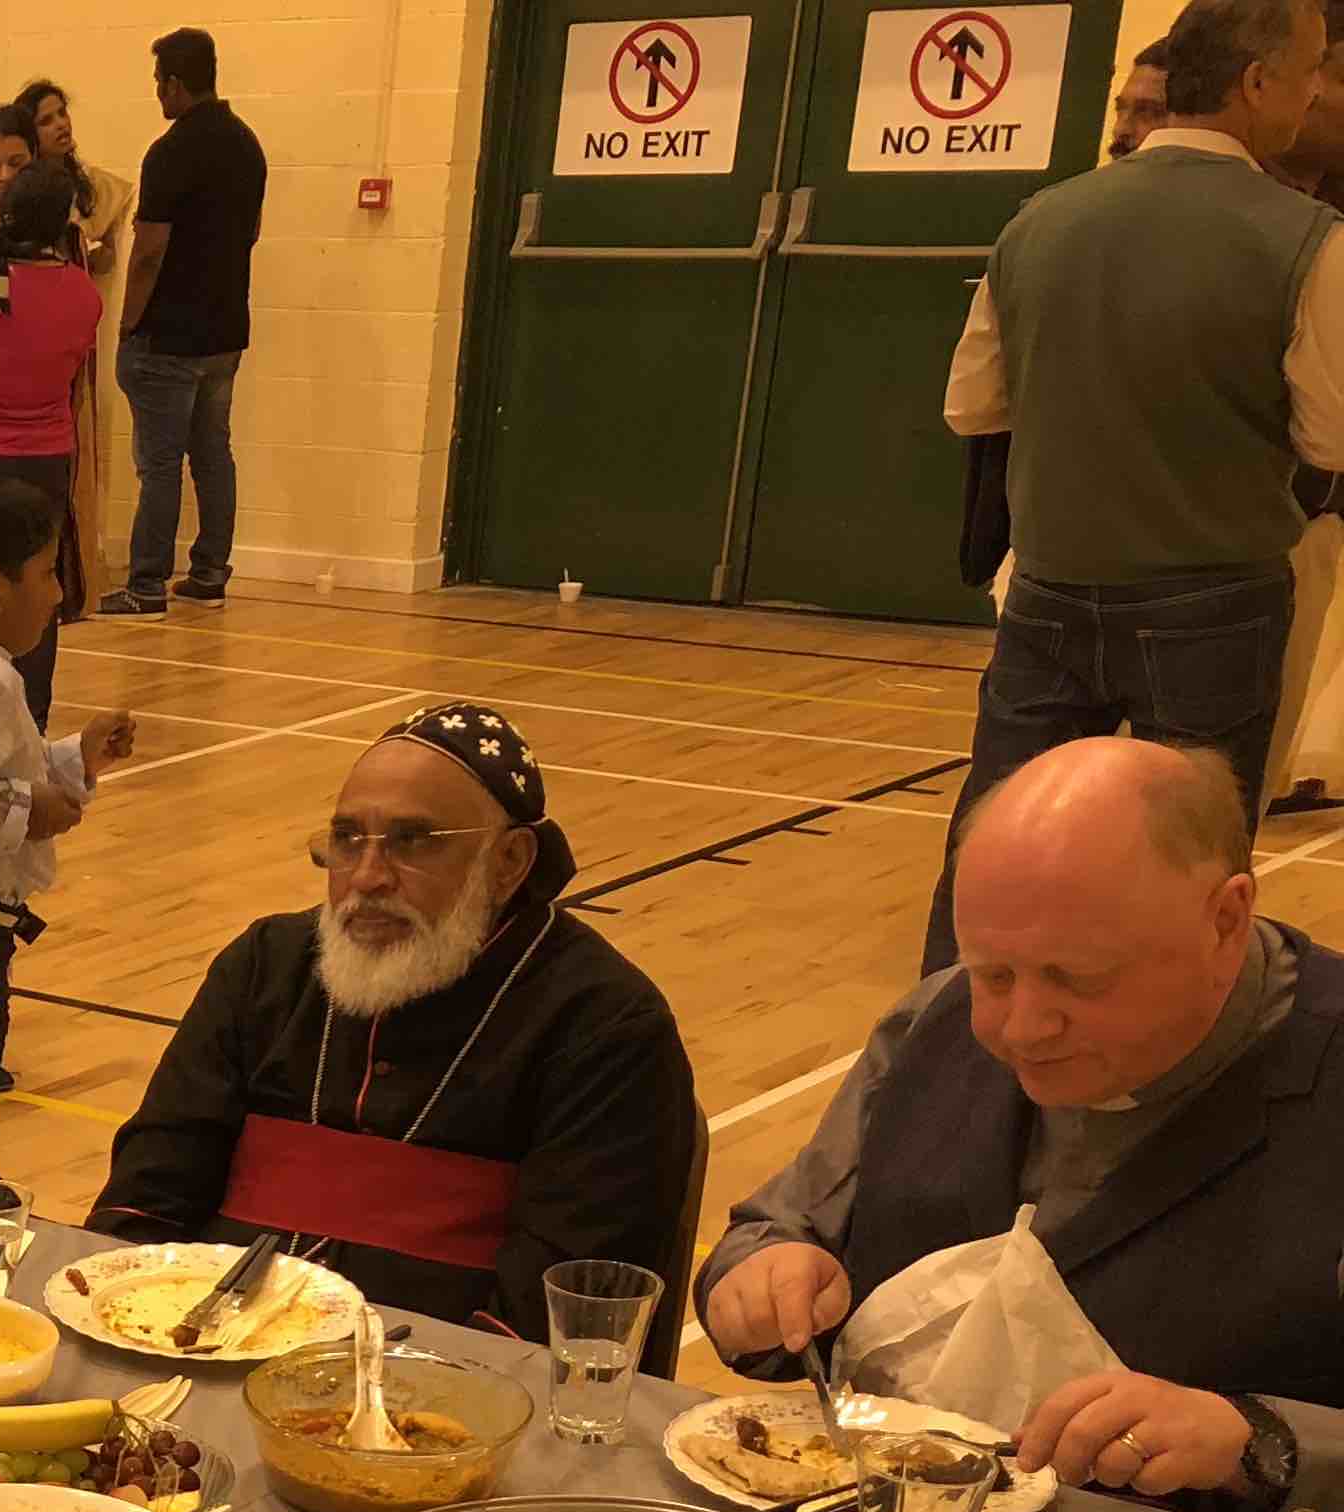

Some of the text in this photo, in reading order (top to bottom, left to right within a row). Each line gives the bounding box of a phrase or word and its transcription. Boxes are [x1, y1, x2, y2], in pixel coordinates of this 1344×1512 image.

[584, 130, 711, 159] NO EXIT
[880, 123, 1022, 155] NO EXIT
